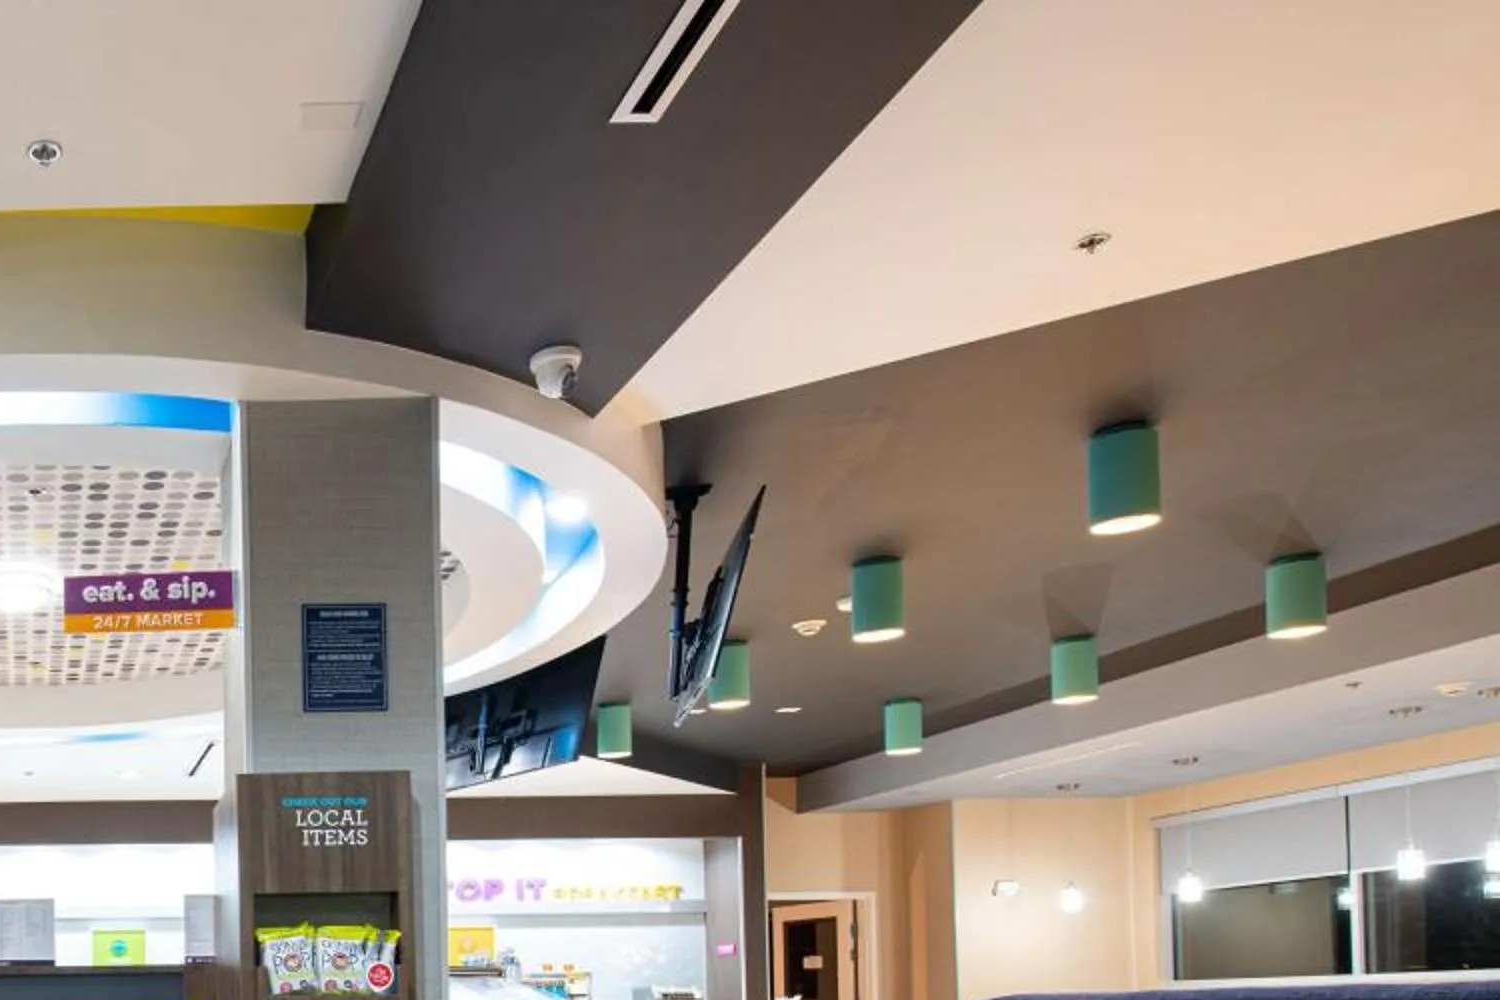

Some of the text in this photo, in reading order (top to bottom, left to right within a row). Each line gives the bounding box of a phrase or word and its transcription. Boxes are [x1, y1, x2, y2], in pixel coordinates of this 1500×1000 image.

[82, 576, 216, 605] eat. & sip.
[93, 613, 204, 629] 24/7 MARKET
[295, 809, 369, 827] LOCAL
[301, 828, 369, 847] ITEMS
[447, 878, 505, 902] OP
[515, 878, 548, 901] IT
